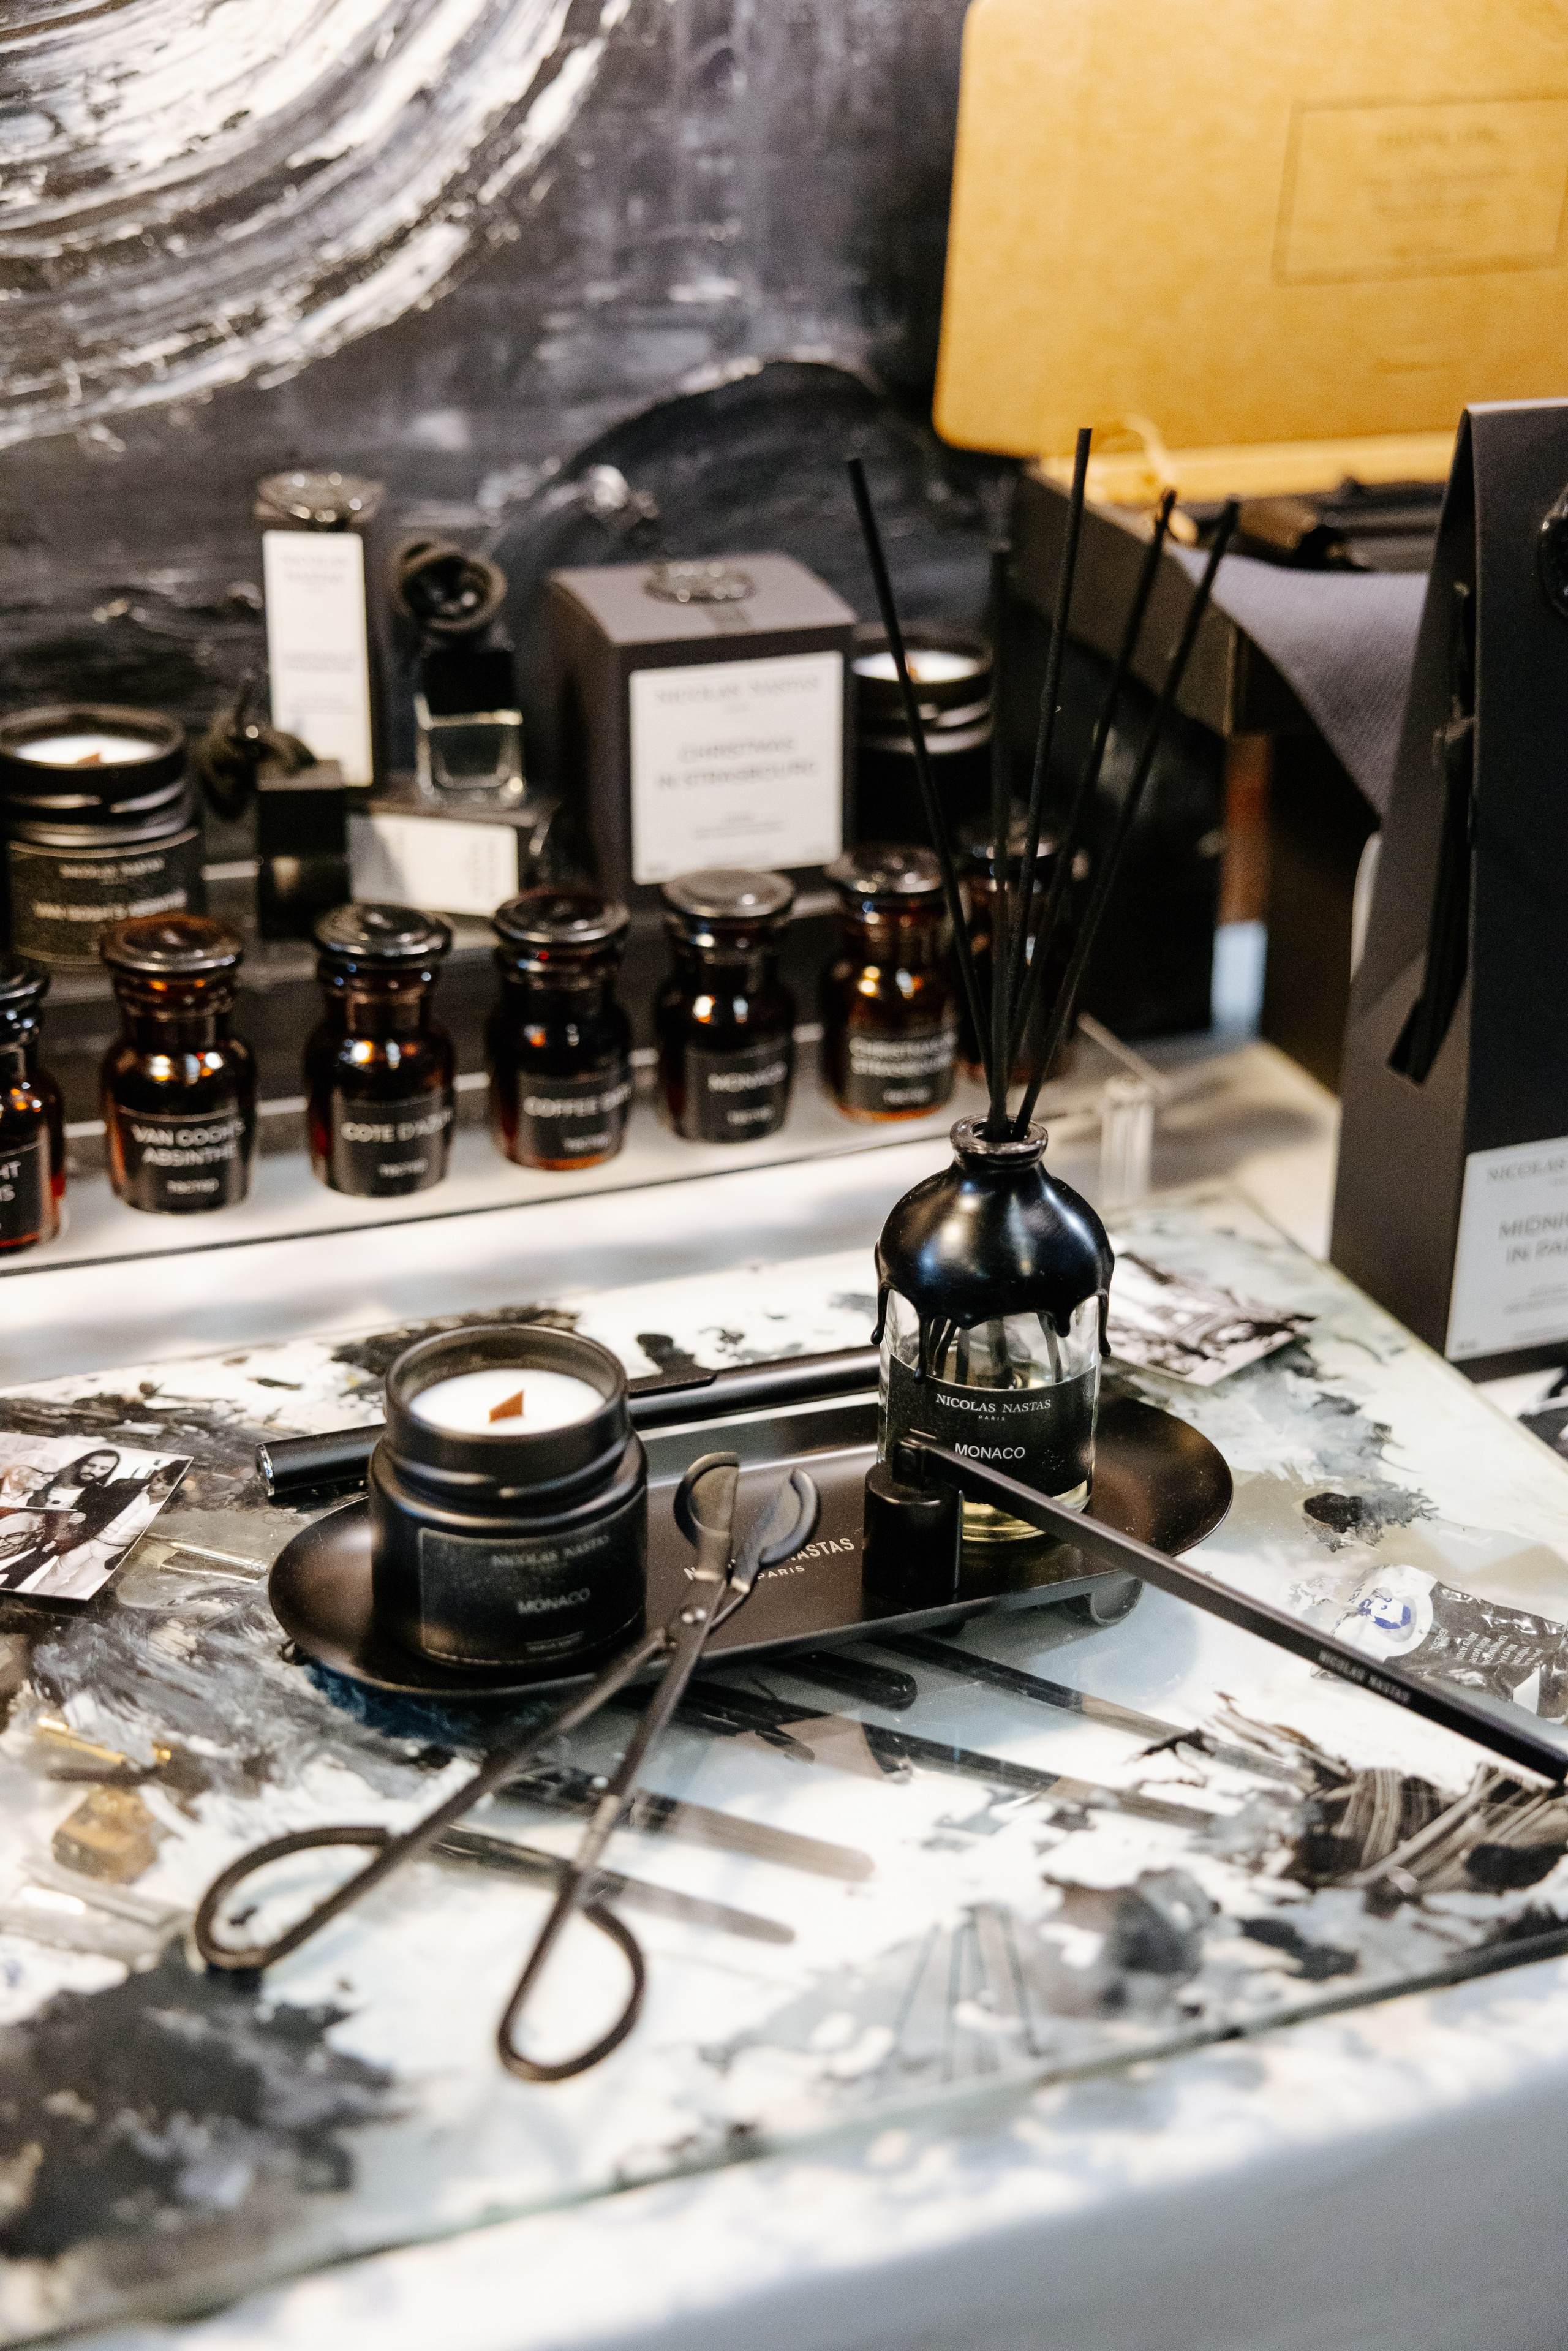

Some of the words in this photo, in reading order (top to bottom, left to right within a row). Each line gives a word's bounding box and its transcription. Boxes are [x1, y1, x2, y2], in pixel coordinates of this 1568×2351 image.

[130, 1123, 175, 1147] VAN
[1499, 1210, 1568, 1239] MIDNI
[935, 1393, 996, 1413] NICOLAS
[1002, 1399, 1052, 1413] NASTAS
[955, 1443, 1026, 1460] MONACO
[786, 1538, 855, 1561] ASTAS
[517, 1587, 590, 1615] MONACO
